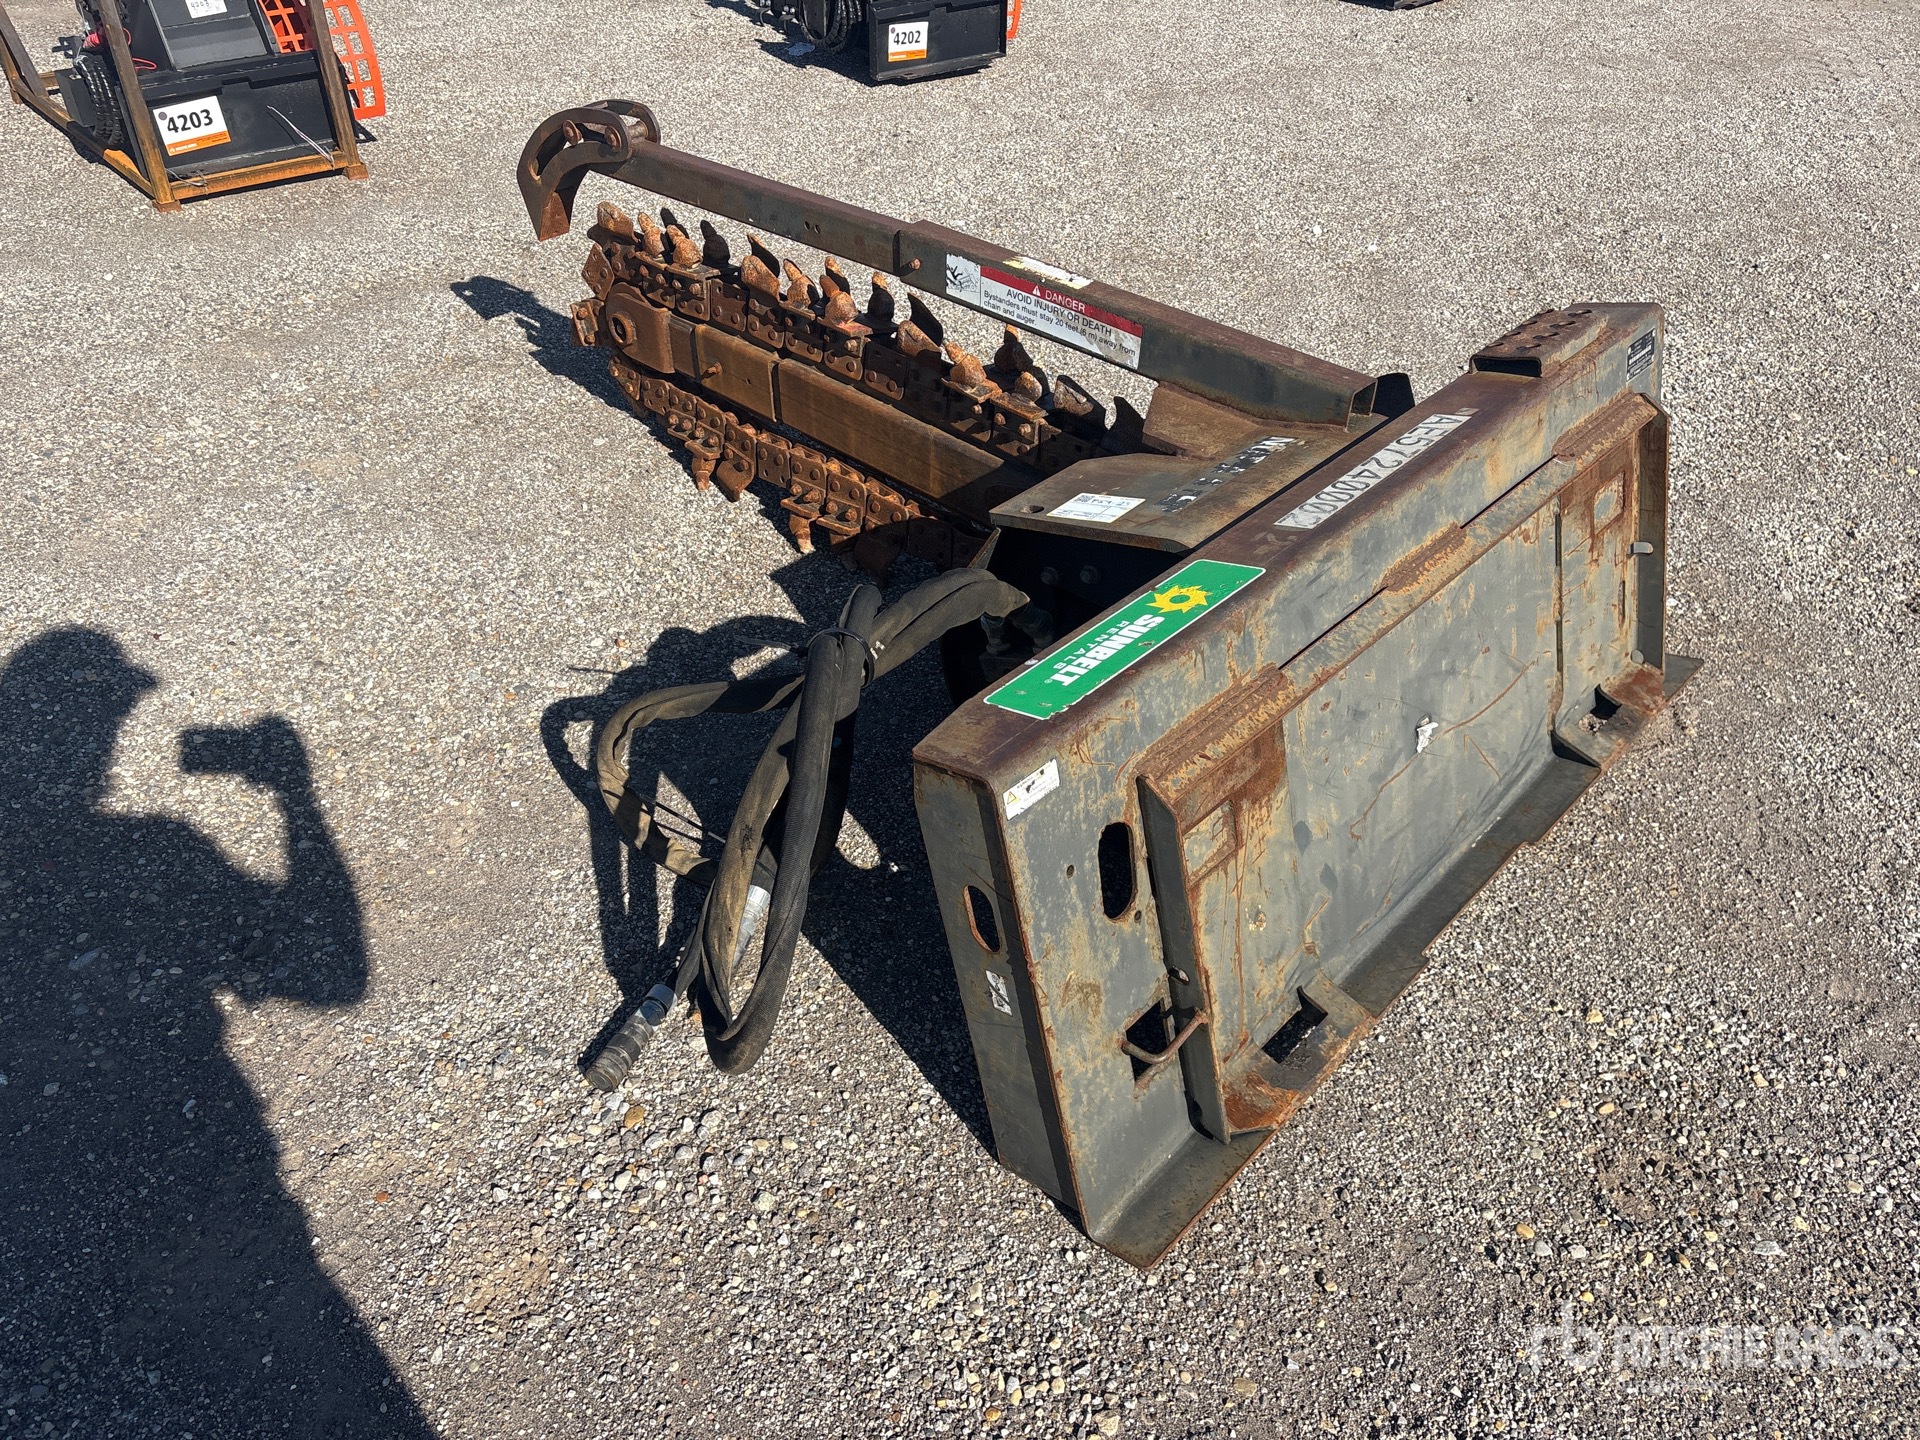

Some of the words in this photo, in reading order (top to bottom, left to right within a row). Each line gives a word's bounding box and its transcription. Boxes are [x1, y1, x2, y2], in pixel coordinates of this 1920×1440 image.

[894, 30, 921, 45] 4202
[167, 109, 213, 133] 4203
[984, 300, 1000, 311] chain
[1003, 307, 1014, 316] and
[1016, 312, 1037, 325] auger.
[1006, 289, 1032, 305] AVOID
[1034, 299, 1065, 317] INJURY
[1067, 312, 1080, 324] OR
[1082, 318, 1112, 336] DEATH
[1045, 290, 1085, 313] DANGER
[984, 290, 1020, 310] Bystanders
[1021, 306, 1038, 317] must
[1040, 313, 1054, 324] stay
[1055, 318, 1064, 327] 20
[1065, 322, 1079, 333] feet
[1080, 327, 1087, 336] (6
[1088, 332, 1098, 341] m)
[1099, 337, 1117, 349] away
[1119, 344, 1136, 356] from
[1050, 614, 1165, 686] SUNBELT
[1053, 621, 1130, 669] RENTALS
